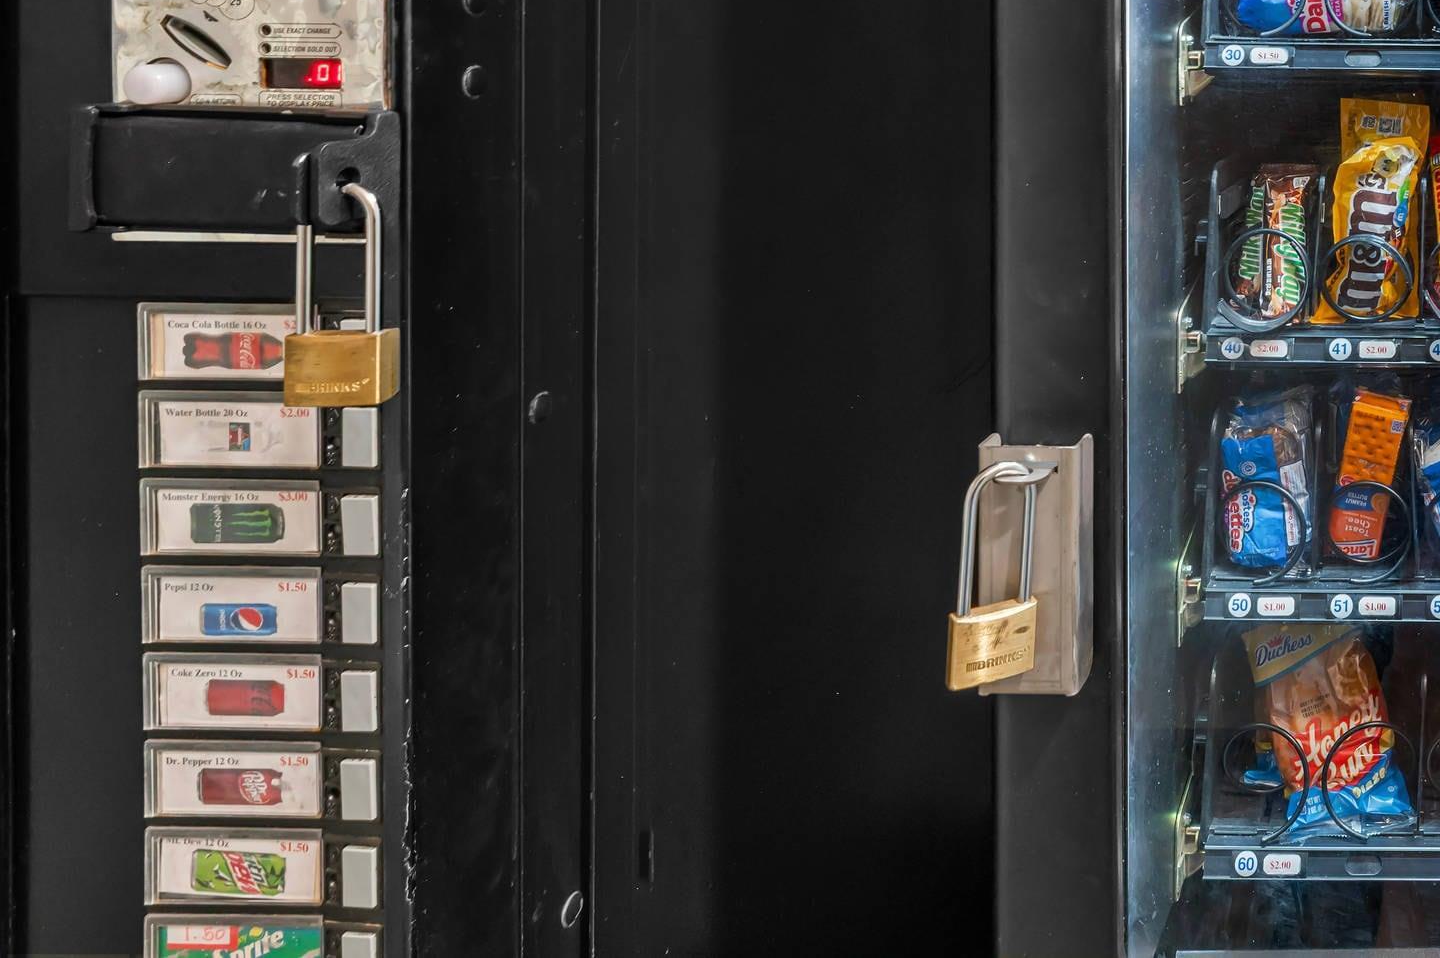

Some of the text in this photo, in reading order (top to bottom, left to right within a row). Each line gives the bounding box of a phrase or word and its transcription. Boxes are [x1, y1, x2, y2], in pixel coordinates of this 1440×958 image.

[287, 27, 305, 35] EXACT
[306, 27, 331, 35] CHANGE
[273, 45, 304, 53] SELECTION
[323, 45, 337, 53] OUT
[167, 320, 267, 329] Coca Cola Bottle 16 Oz
[1332, 343, 1347, 354] 41
[1366, 346, 1387, 354] $2.00
[165, 408, 248, 417] Water Bottle 20 Oz
[279, 408, 310, 419] $2.00
[162, 493, 259, 503] Monster Energy 16 Oz
[278, 491, 308, 502] $3.00
[1345, 525, 1370, 537] Toast
[164, 583, 214, 593] Pepsi 12 Oz
[278, 582, 307, 592] $1.50
[1231, 598, 1248, 611] 50
[1263, 602, 1286, 611] $1.00
[1333, 599, 1349, 612] 51
[1364, 602, 1387, 611] $1.00
[1255, 632, 1313, 667] Duchess
[977, 649, 1025, 670] BRINKS
[171, 668, 243, 678] Coke Zero 12 Oz
[286, 668, 315, 679] $1.50
[165, 756, 239, 768] Dr. Pepper 12 Oz
[279, 756, 309, 767] $1.50
[217, 839, 230, 848] Oz
[279, 841, 309, 853] $1.50
[1237, 857, 1255, 871] 60
[1269, 859, 1292, 870] $2.00
